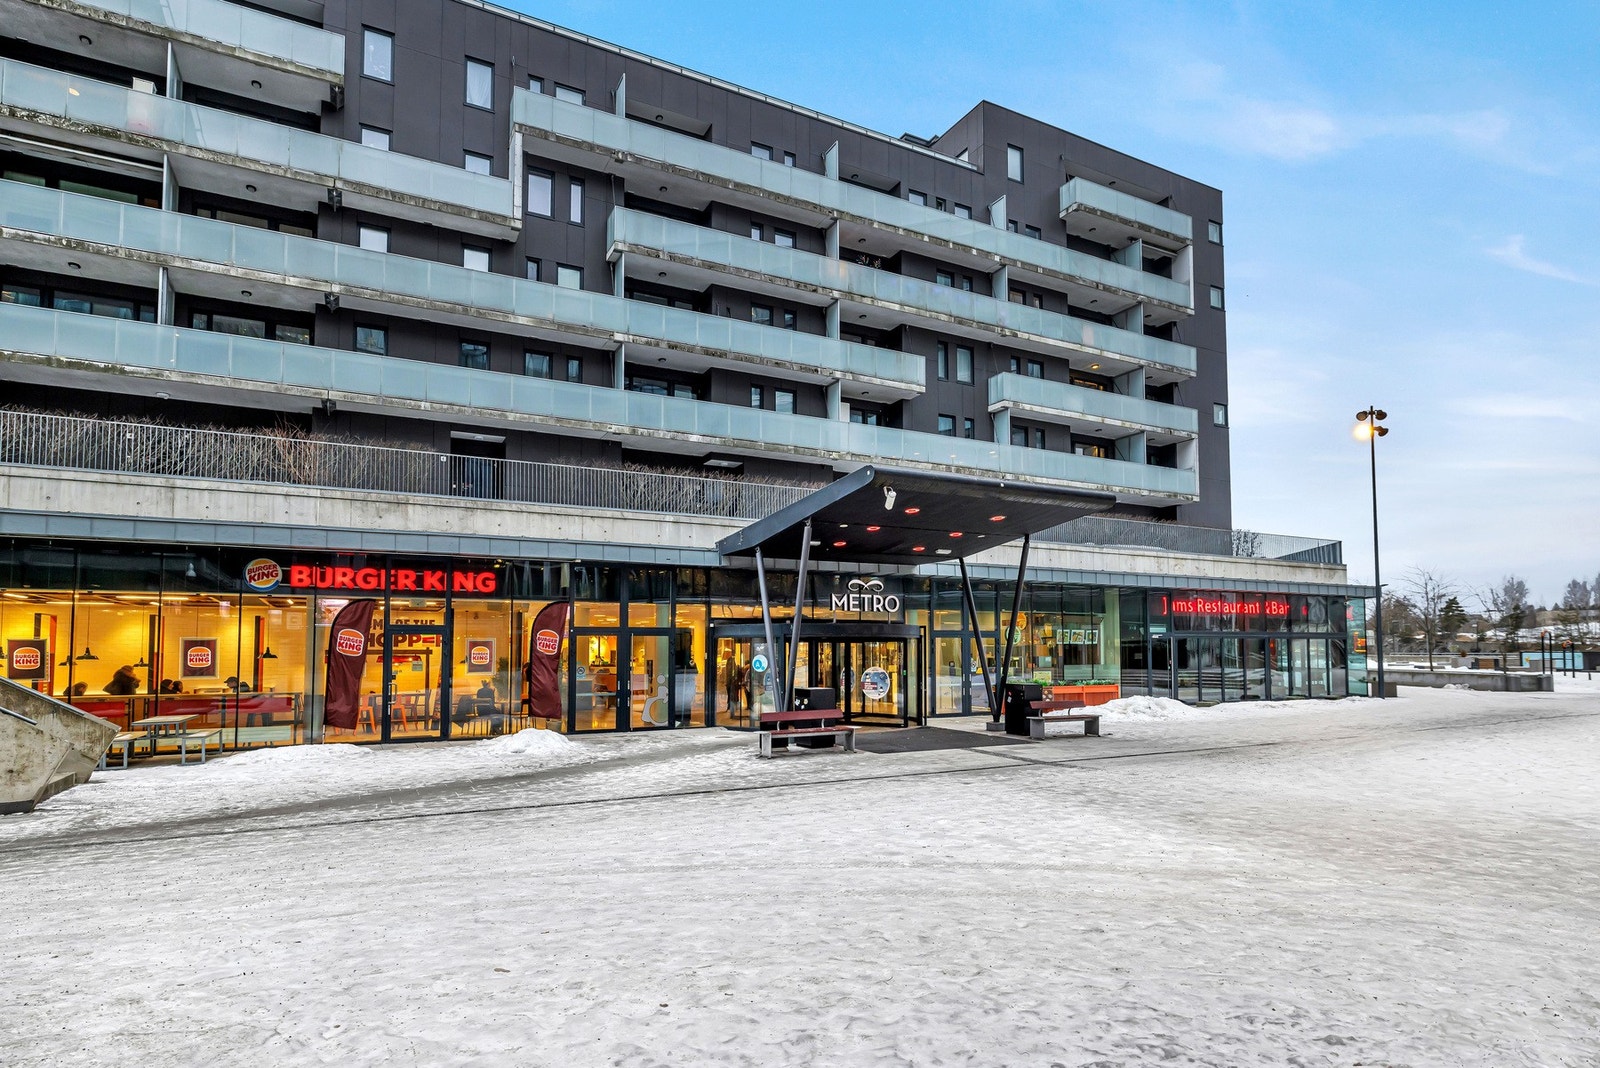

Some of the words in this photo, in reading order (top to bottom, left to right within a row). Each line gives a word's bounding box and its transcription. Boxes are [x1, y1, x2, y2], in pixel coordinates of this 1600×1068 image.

[247, 564, 278, 576] BURGER
[248, 570, 279, 584] KING
[290, 565, 417, 591] BURGER
[831, 593, 900, 613] METRO
[1197, 598, 1260, 614] Restaurant
[338, 641, 362, 651] KING
[538, 641, 557, 650] KING
